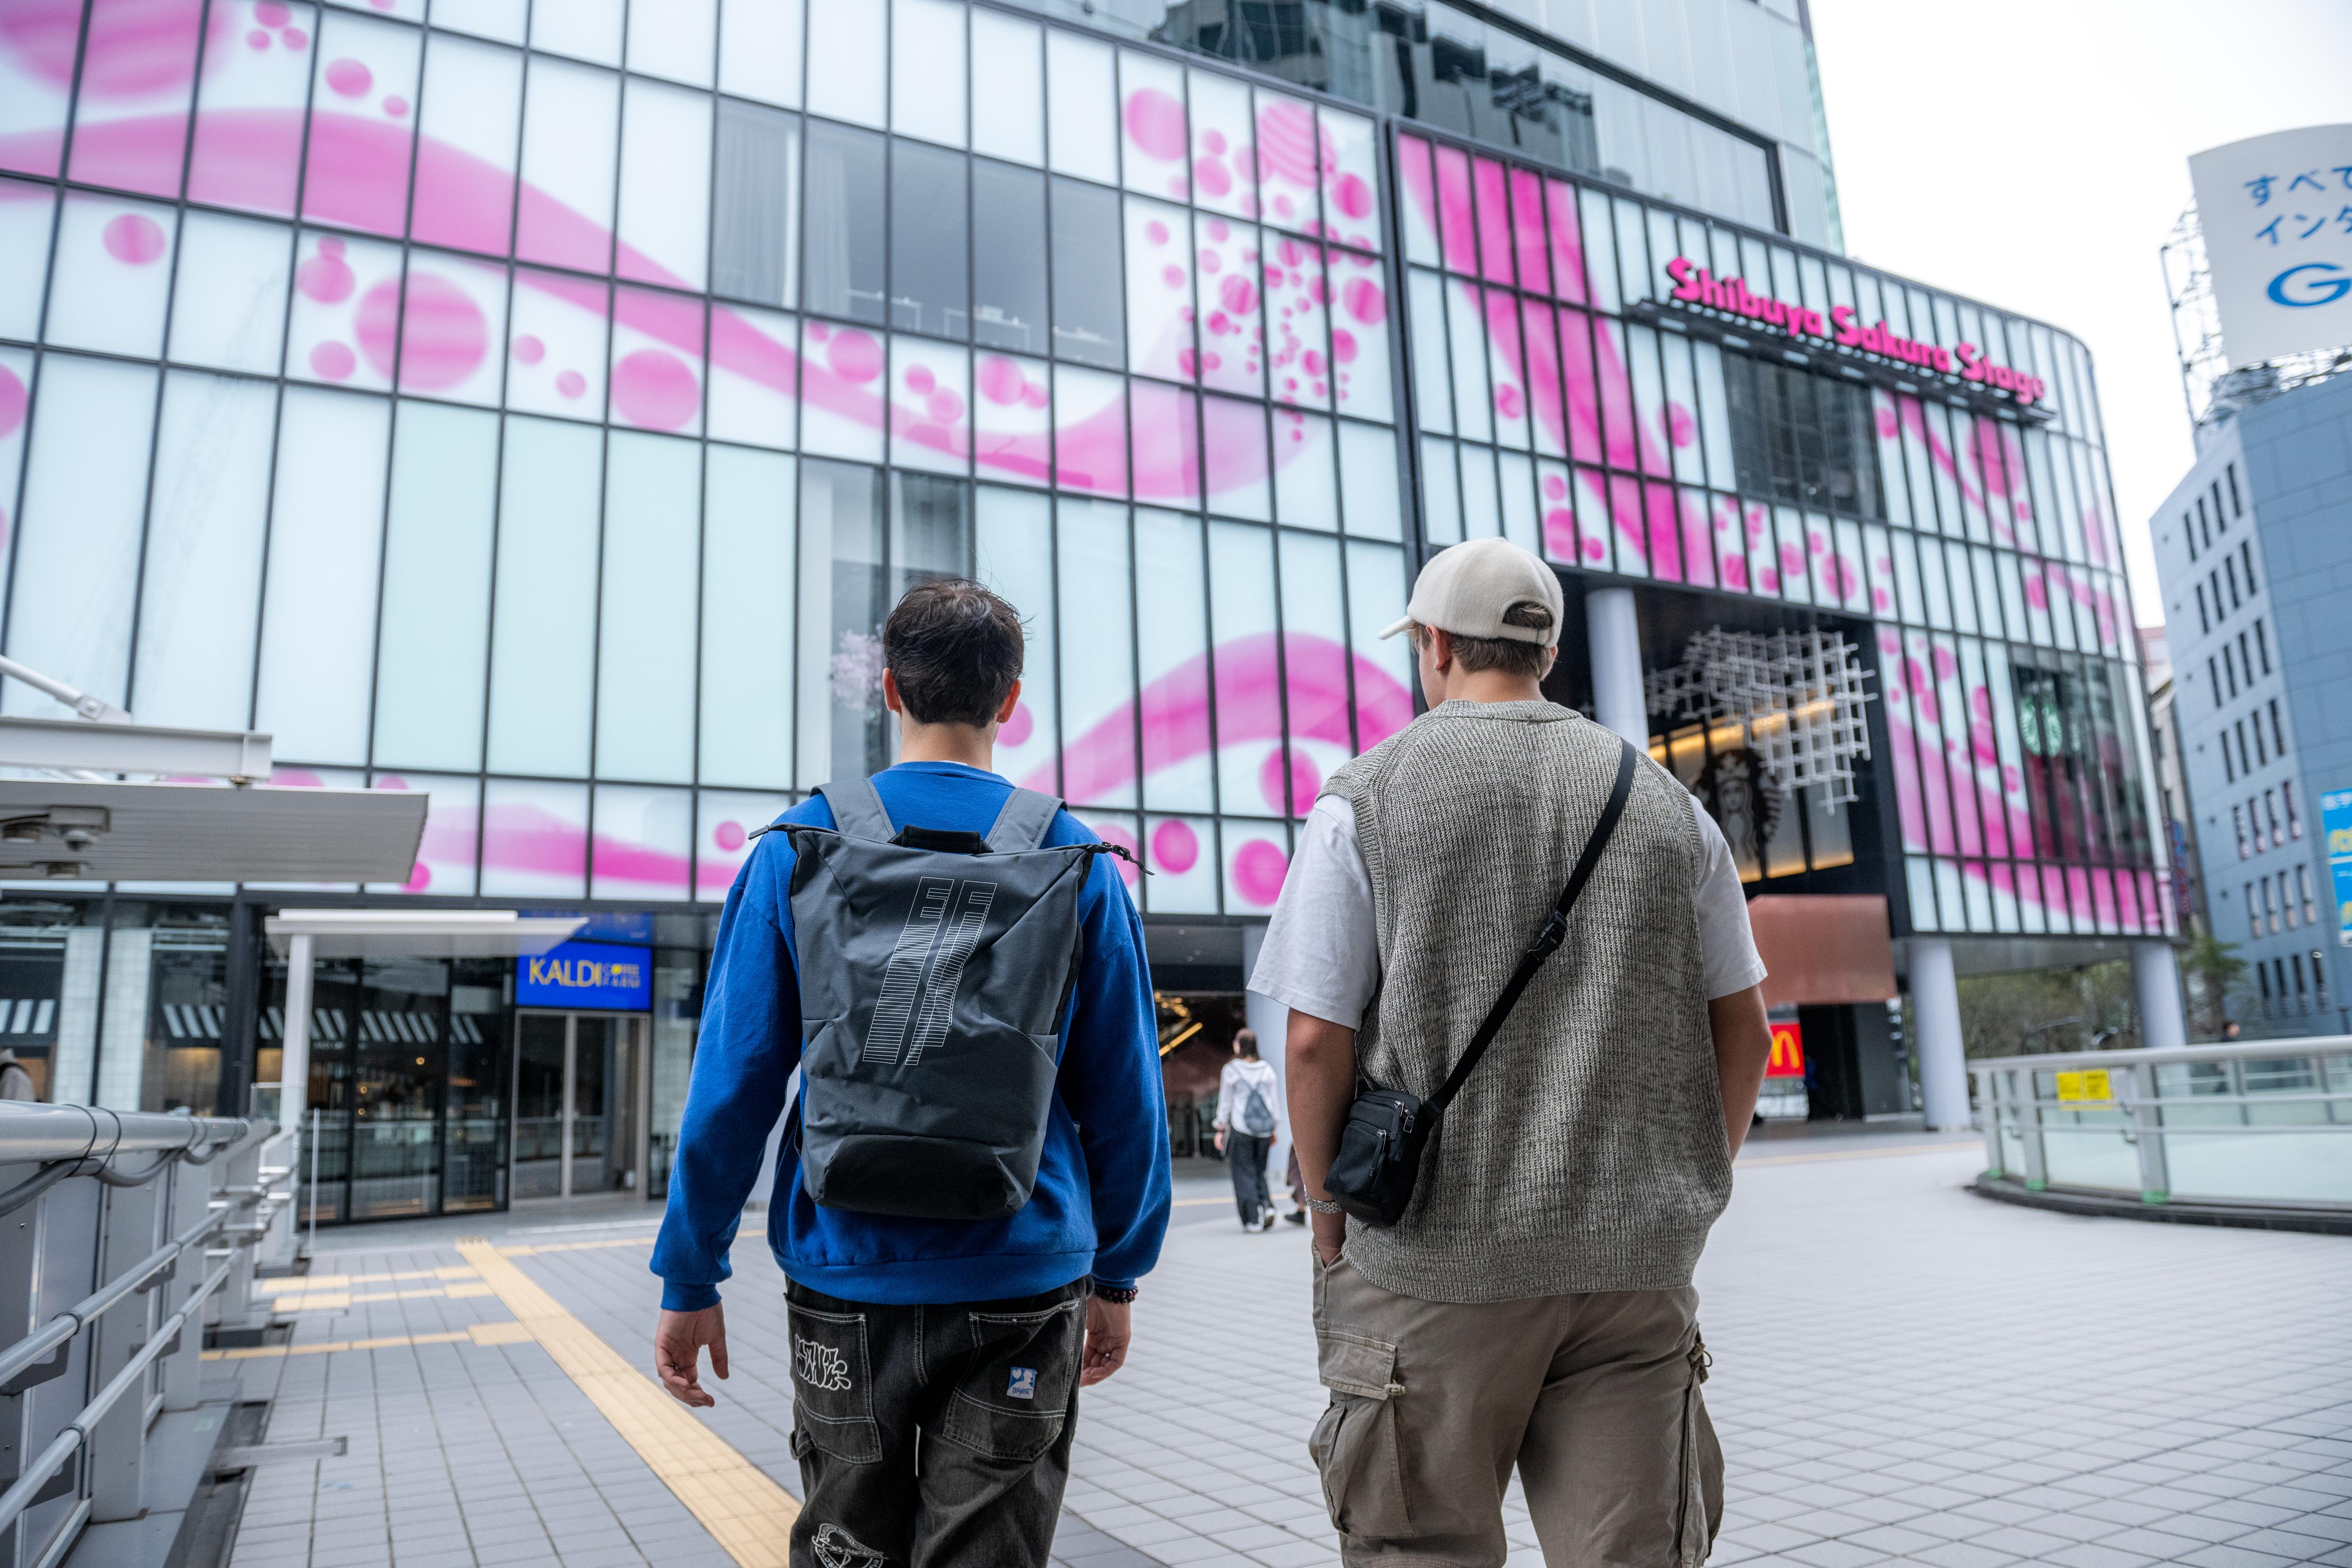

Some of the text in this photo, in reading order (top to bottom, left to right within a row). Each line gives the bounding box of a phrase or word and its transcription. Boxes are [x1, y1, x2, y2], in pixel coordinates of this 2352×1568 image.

[2266, 262, 2352, 308] G
[1667, 256, 2044, 405] Shibuya Sakura Stage
[529, 957, 602, 987] KALDI
